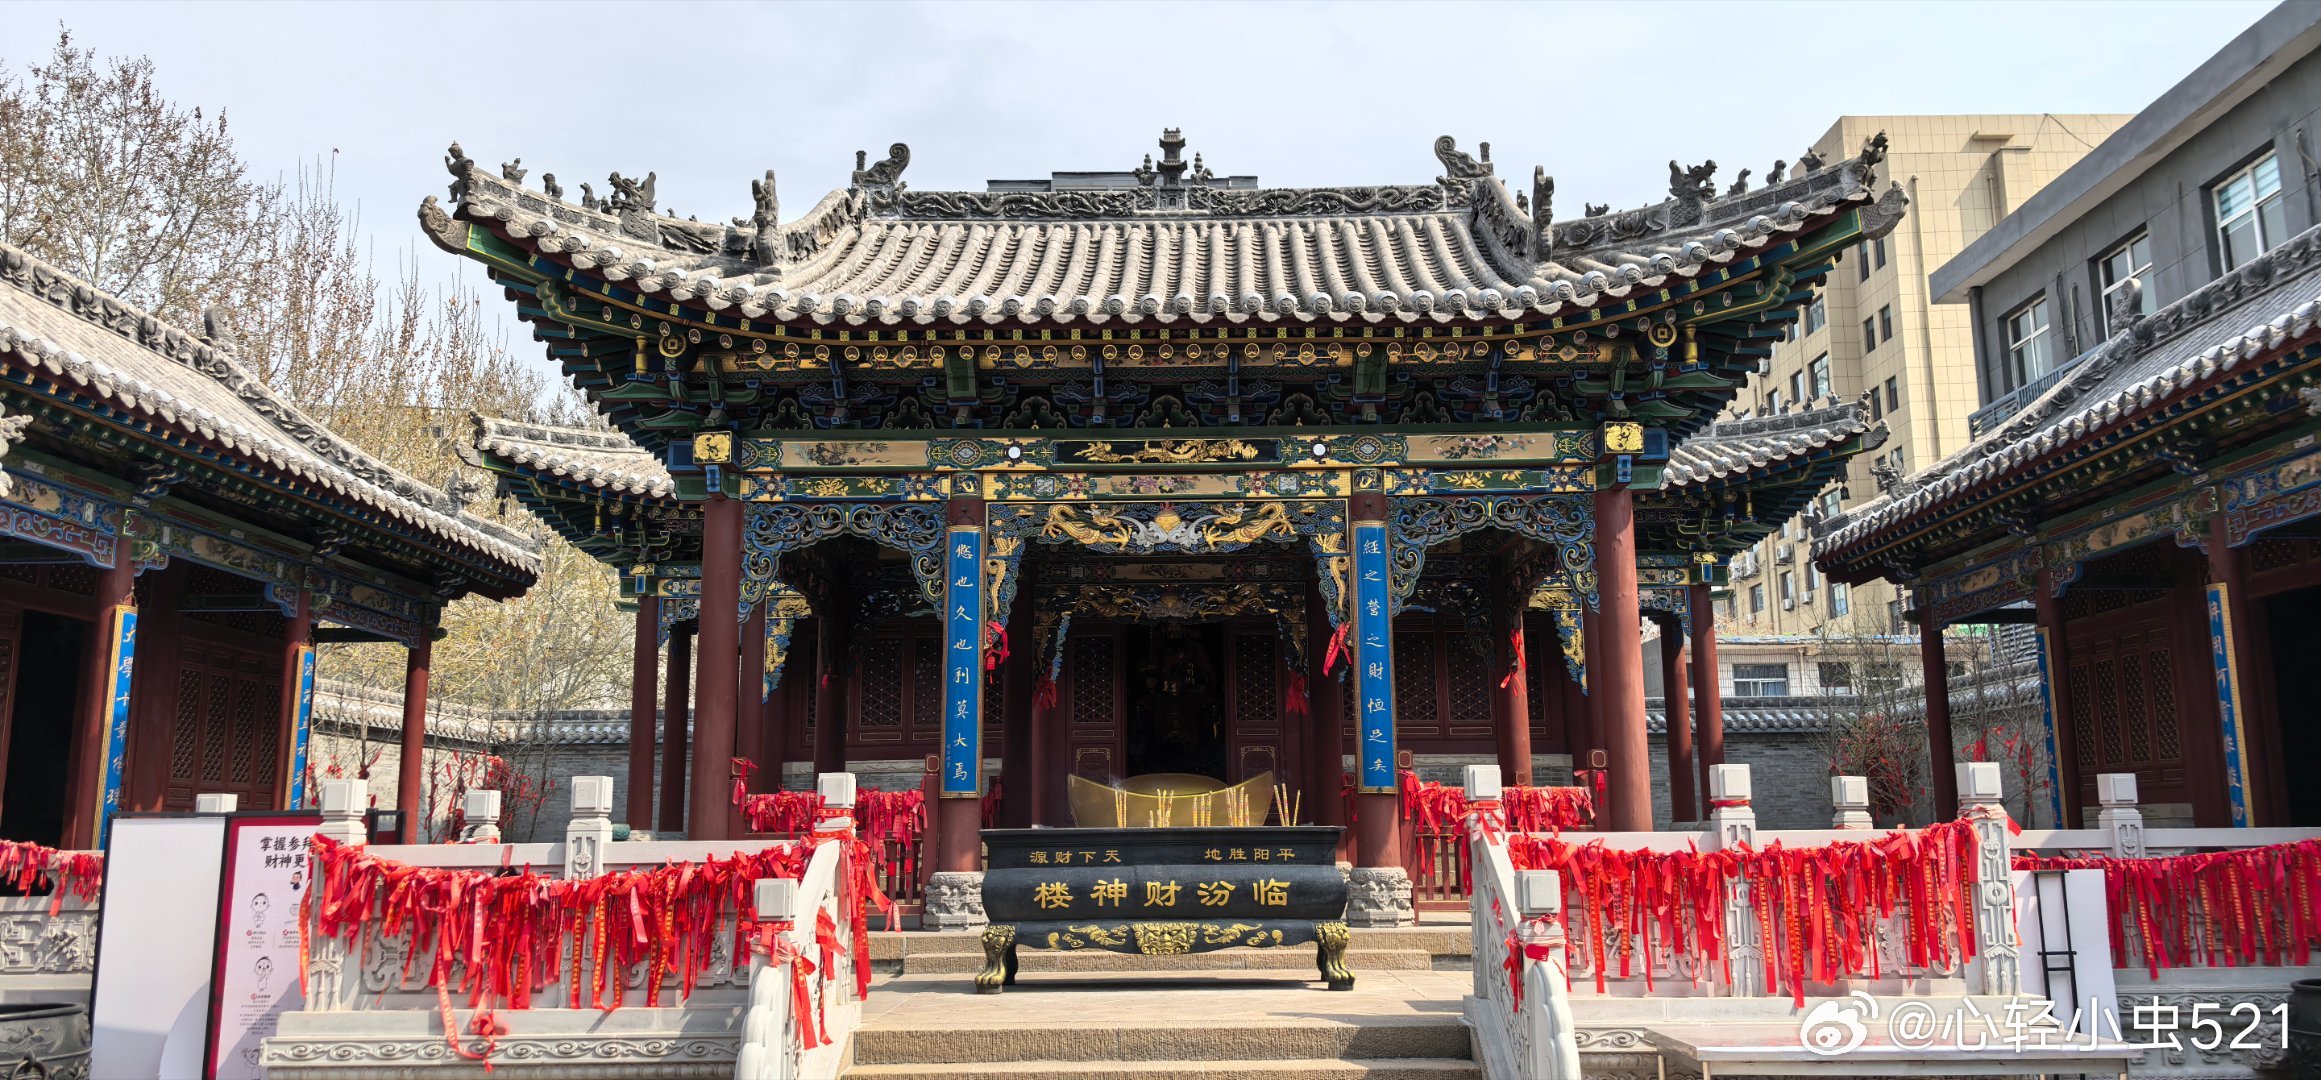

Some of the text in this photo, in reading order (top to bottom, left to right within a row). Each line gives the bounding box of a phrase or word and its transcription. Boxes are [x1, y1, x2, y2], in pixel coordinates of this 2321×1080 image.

[1033, 878, 1291, 909] 临汾财神楼
